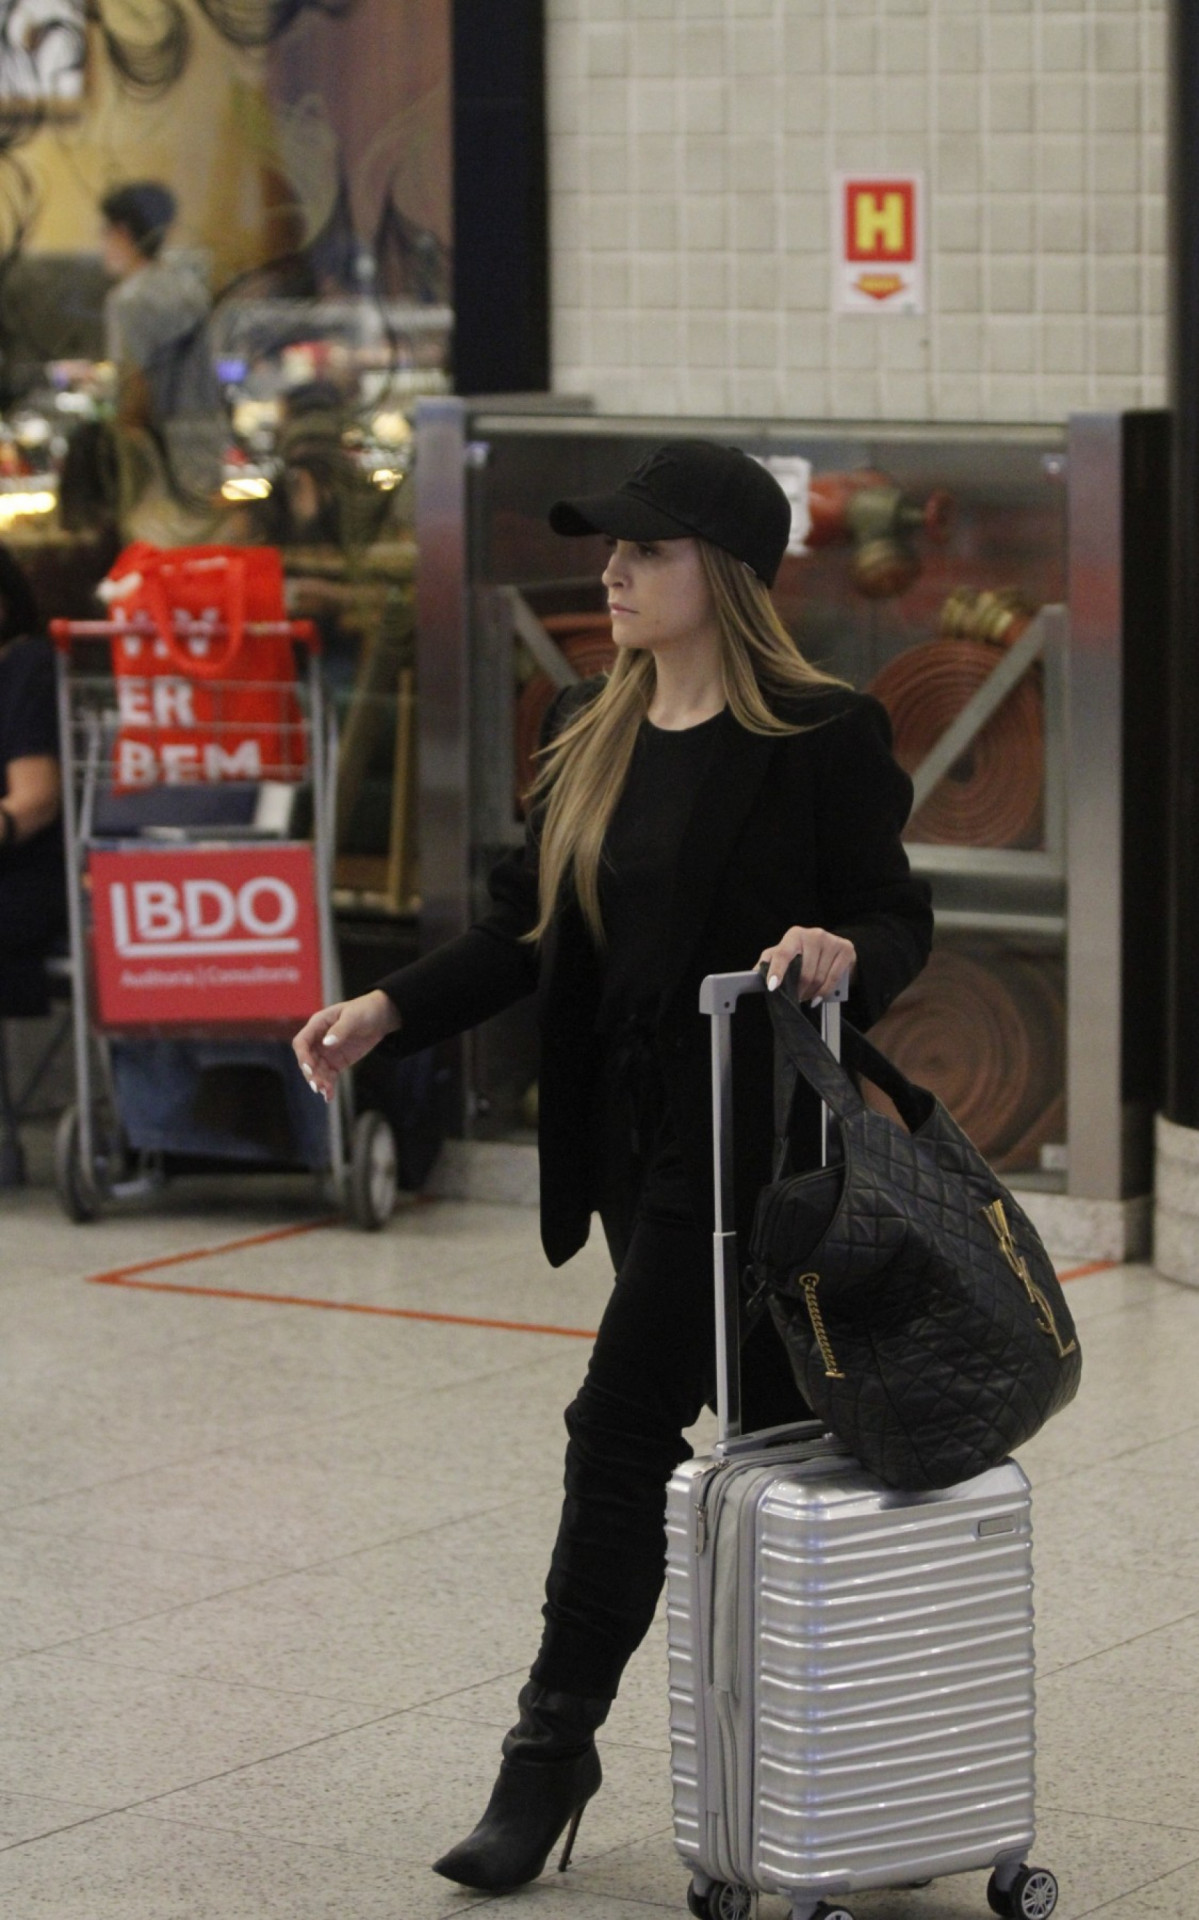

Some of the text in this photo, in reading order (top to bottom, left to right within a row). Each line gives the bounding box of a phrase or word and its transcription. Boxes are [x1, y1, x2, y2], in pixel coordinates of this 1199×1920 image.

[856, 193, 903, 251] H
[117, 675, 195, 727] ER
[119, 738, 261, 786] BEM
[133, 876, 297, 940] BDO
